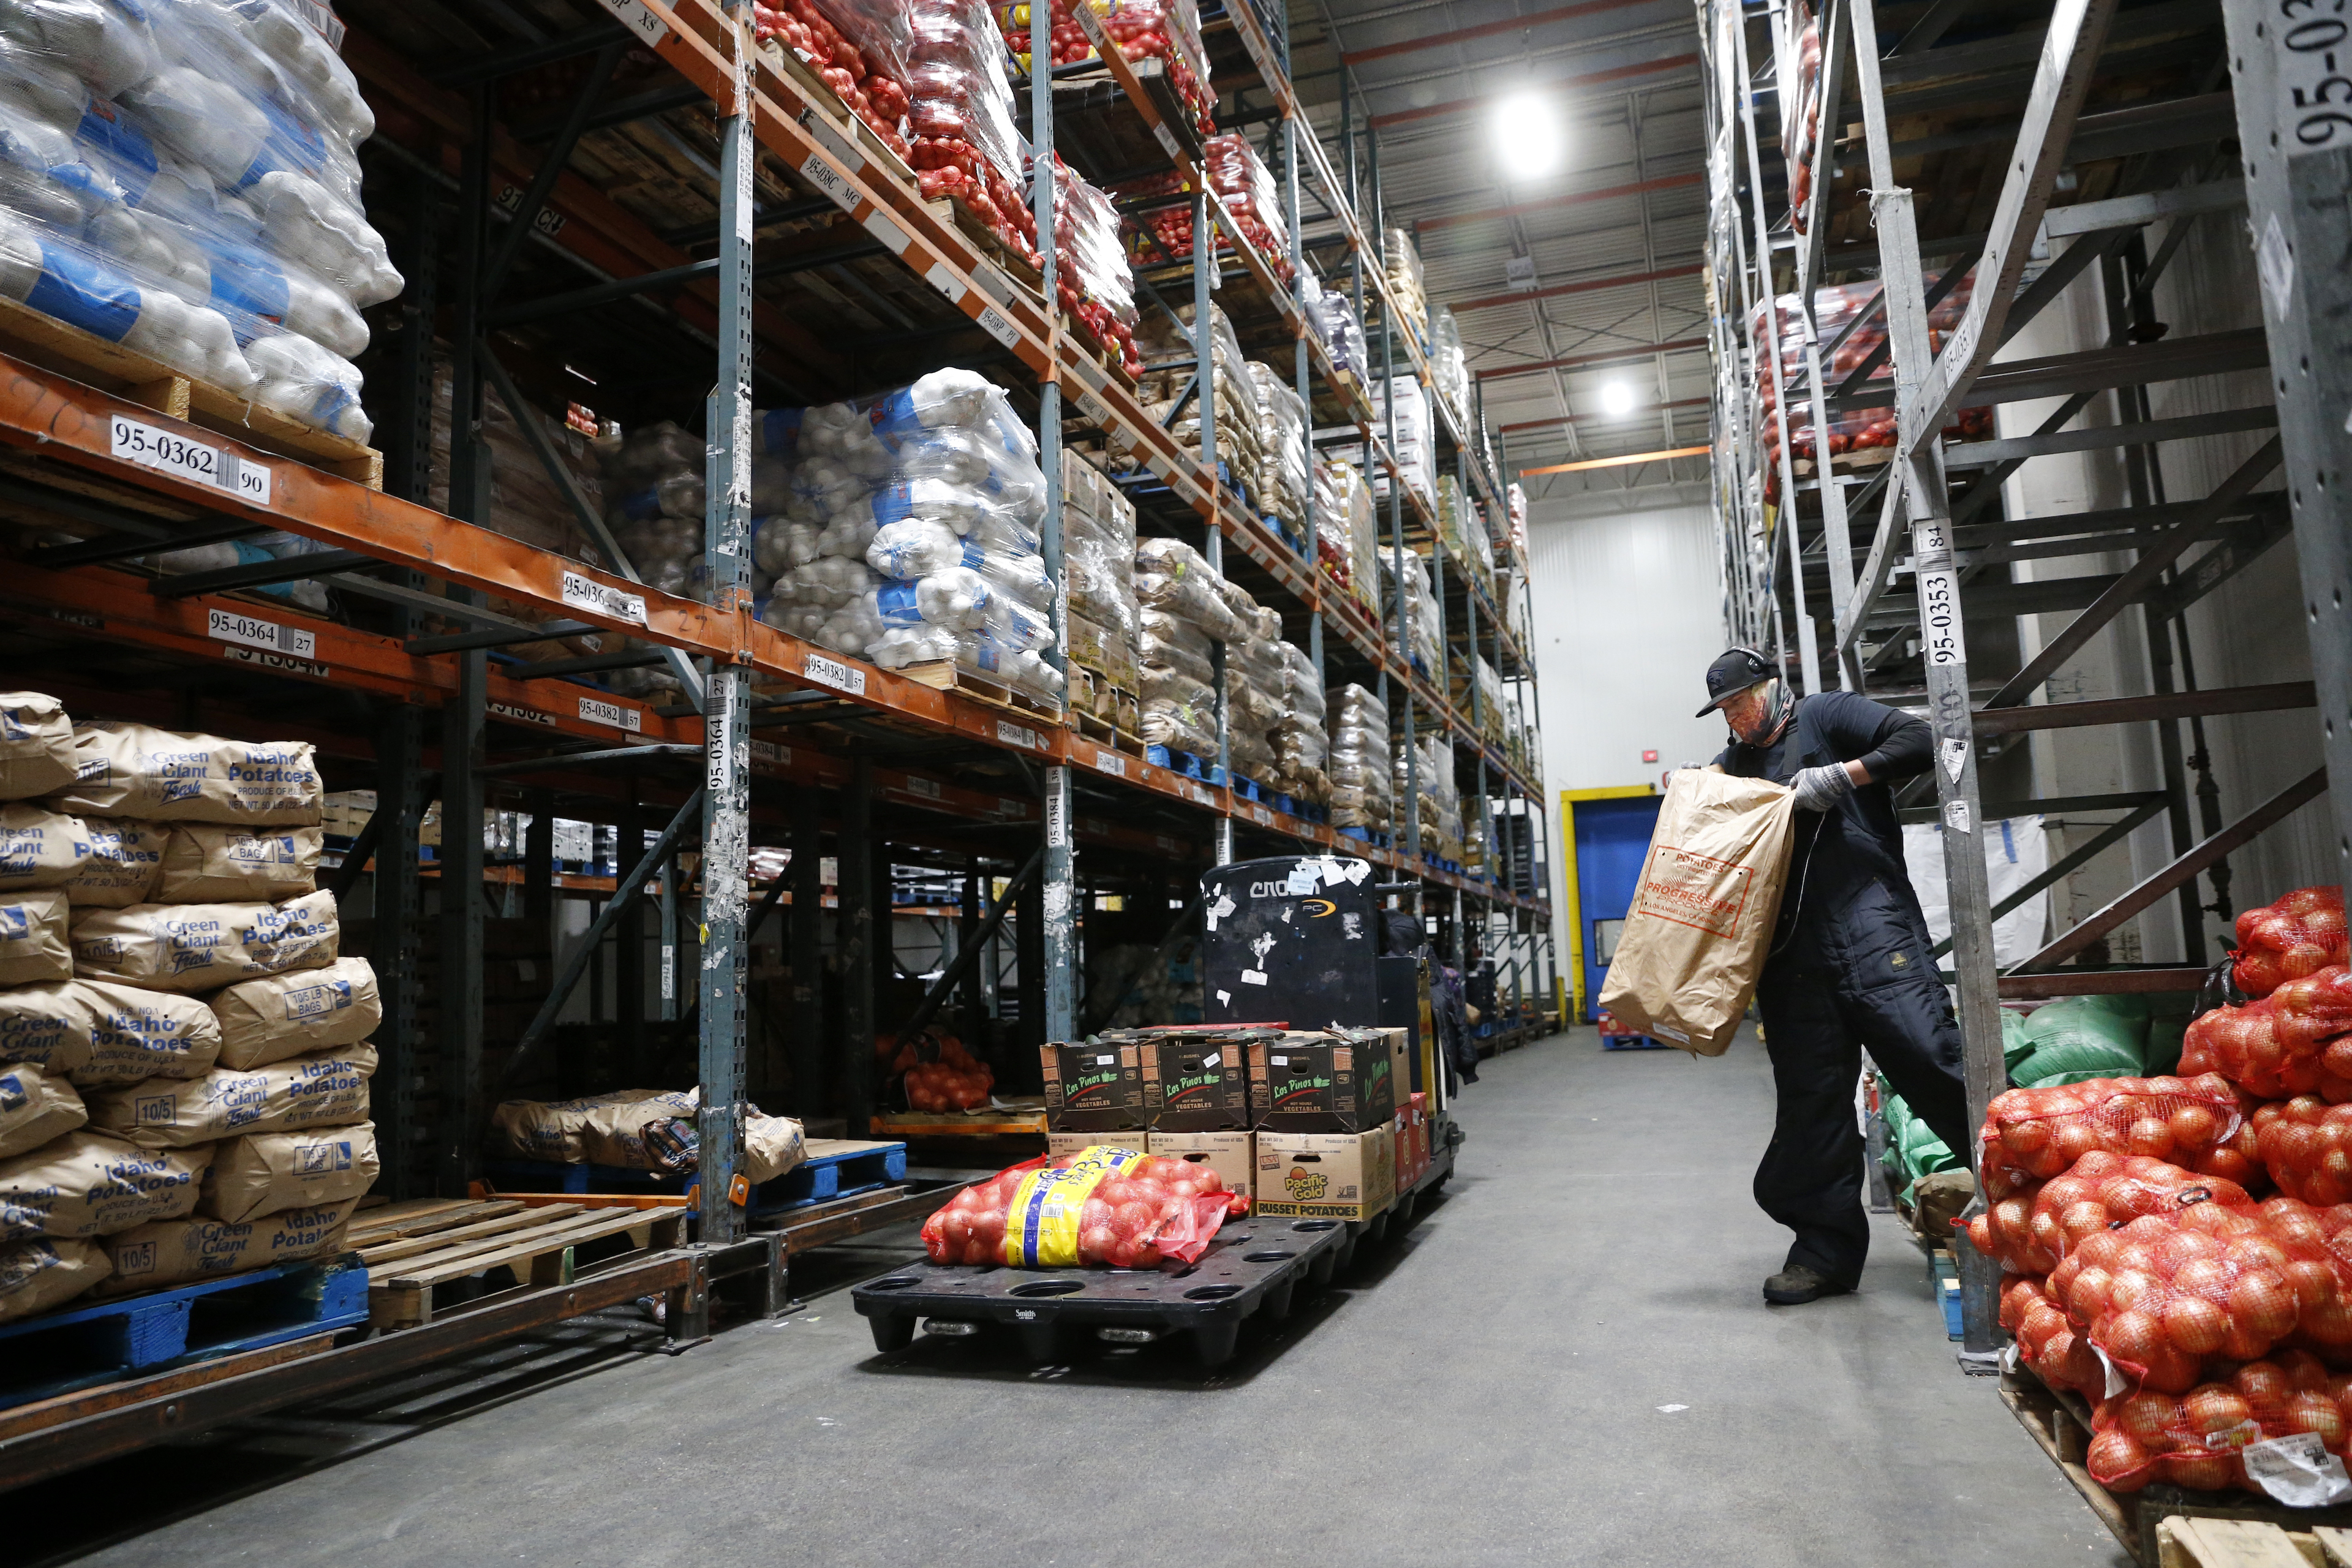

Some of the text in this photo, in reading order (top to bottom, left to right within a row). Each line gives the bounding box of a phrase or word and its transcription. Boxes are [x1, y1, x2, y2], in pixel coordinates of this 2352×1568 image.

[638, 11, 656, 31] XS
[807, 158, 859, 205] 95-038C MC
[982, 311, 1016, 341] 95-038P PJ
[1946, 323, 1970, 378] 95-035
[116, 423, 263, 492] 95-0362 90
[1928, 526, 1944, 547] 84
[565, 576, 643, 616] 95-036 27
[1928, 577, 1956, 663] 95-0353
[211, 613, 311, 650] 95-0364 27
[811, 658, 862, 688] 95-0382 57
[715, 679, 723, 695] 27
[580, 700, 638, 726] 95-0382 57
[153, 752, 209, 763] Green
[246, 752, 295, 765] Idaho
[710, 718, 723, 788] 95-0364
[162, 763, 208, 778] Giant
[229, 766, 314, 783] Potatoes
[1052, 769, 1058, 782] 38
[159, 780, 202, 805] Fresh
[238, 787, 287, 796] PRODUCE OF
[228, 801, 243, 810] NET
[1050, 797, 1060, 844] 95-0384
[239, 848, 265, 859] BAGS
[1676, 854, 1725, 873] POTATOES
[1646, 883, 1736, 914] PROGRESSIVE
[1656, 895, 1719, 916] PRODUCE
[167, 920, 219, 933] Green
[257, 908, 309, 927] Idaho
[173, 933, 220, 949] Giant
[243, 922, 327, 945] Potatoes
[253, 943, 300, 958] PRODUCE OF
[172, 949, 214, 975] Fresh
[243, 963, 258, 973] NET
[293, 989, 322, 1003] 10/5 LB
[299, 1001, 322, 1014] BAGS
[2, 1017, 68, 1033] Green
[107, 1014, 176, 1032] Idaho
[2, 1032, 62, 1050] Giant
[91, 1030, 192, 1051] Potatoes
[301, 1060, 353, 1079] Idaho
[215, 1075, 268, 1093] Green
[1066, 1074, 1101, 1096] Los Pinos
[1166, 1076, 1202, 1098] Los Pinos
[1274, 1079, 1312, 1099] Los Pinos
[223, 1090, 268, 1107] Giant
[1076, 1099, 1110, 1108] VEGETABLES
[141, 1100, 171, 1121] 10/5
[225, 1104, 262, 1129] Fresh
[317, 1148, 326, 1158] LB
[1262, 1156, 1278, 1164] USA
[105, 1159, 167, 1181] Idaho
[304, 1159, 324, 1171] BAGS
[86, 1172, 190, 1205] Potatoes
[1285, 1173, 1328, 1191] Pacific
[1293, 1185, 1325, 1200] Gold
[1259, 1203, 1359, 1216] RUSSET POTATOES
[286, 1210, 336, 1230] Idaho
[201, 1224, 252, 1238] Green
[202, 1237, 248, 1254] Giant
[123, 1247, 151, 1268] 10/5
[1016, 1308, 1036, 1317] Smith's
